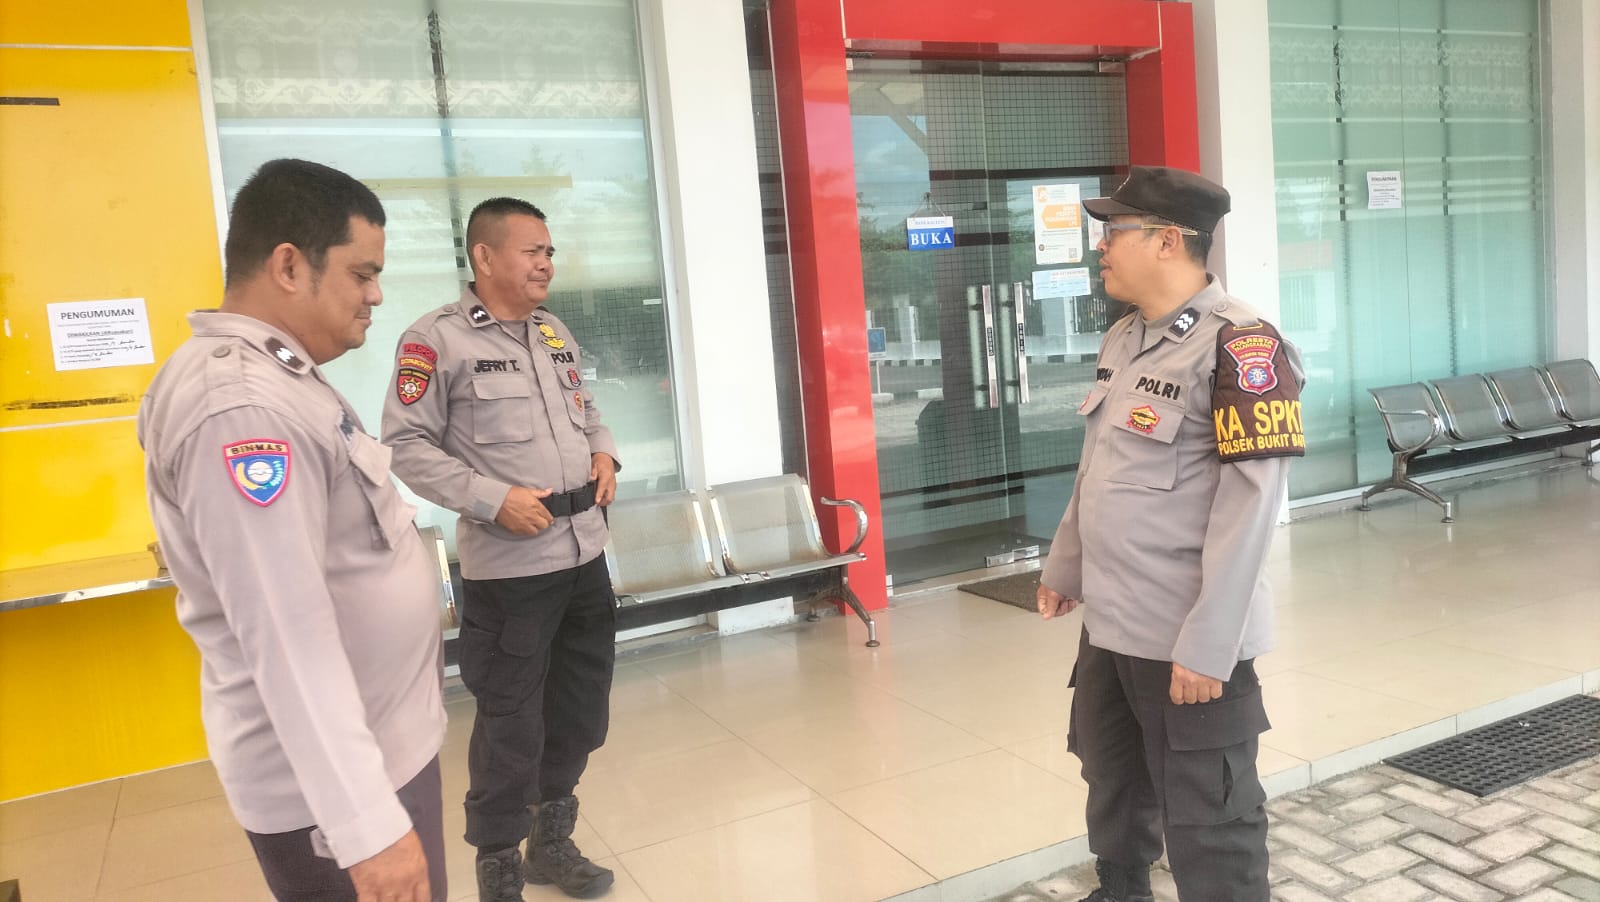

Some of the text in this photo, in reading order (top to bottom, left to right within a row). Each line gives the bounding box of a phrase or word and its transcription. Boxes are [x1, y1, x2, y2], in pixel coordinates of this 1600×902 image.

[910, 231, 953, 246] BUKA
[60, 308, 135, 320] PENGUMUMAN
[509, 360, 520, 372] T.
[1135, 376, 1181, 400] POLRI
[1214, 405, 1245, 441] KA
[230, 443, 283, 455] BINMAS
[1218, 437, 1254, 456] POLSEK
[1257, 433, 1289, 450] BUKIT
